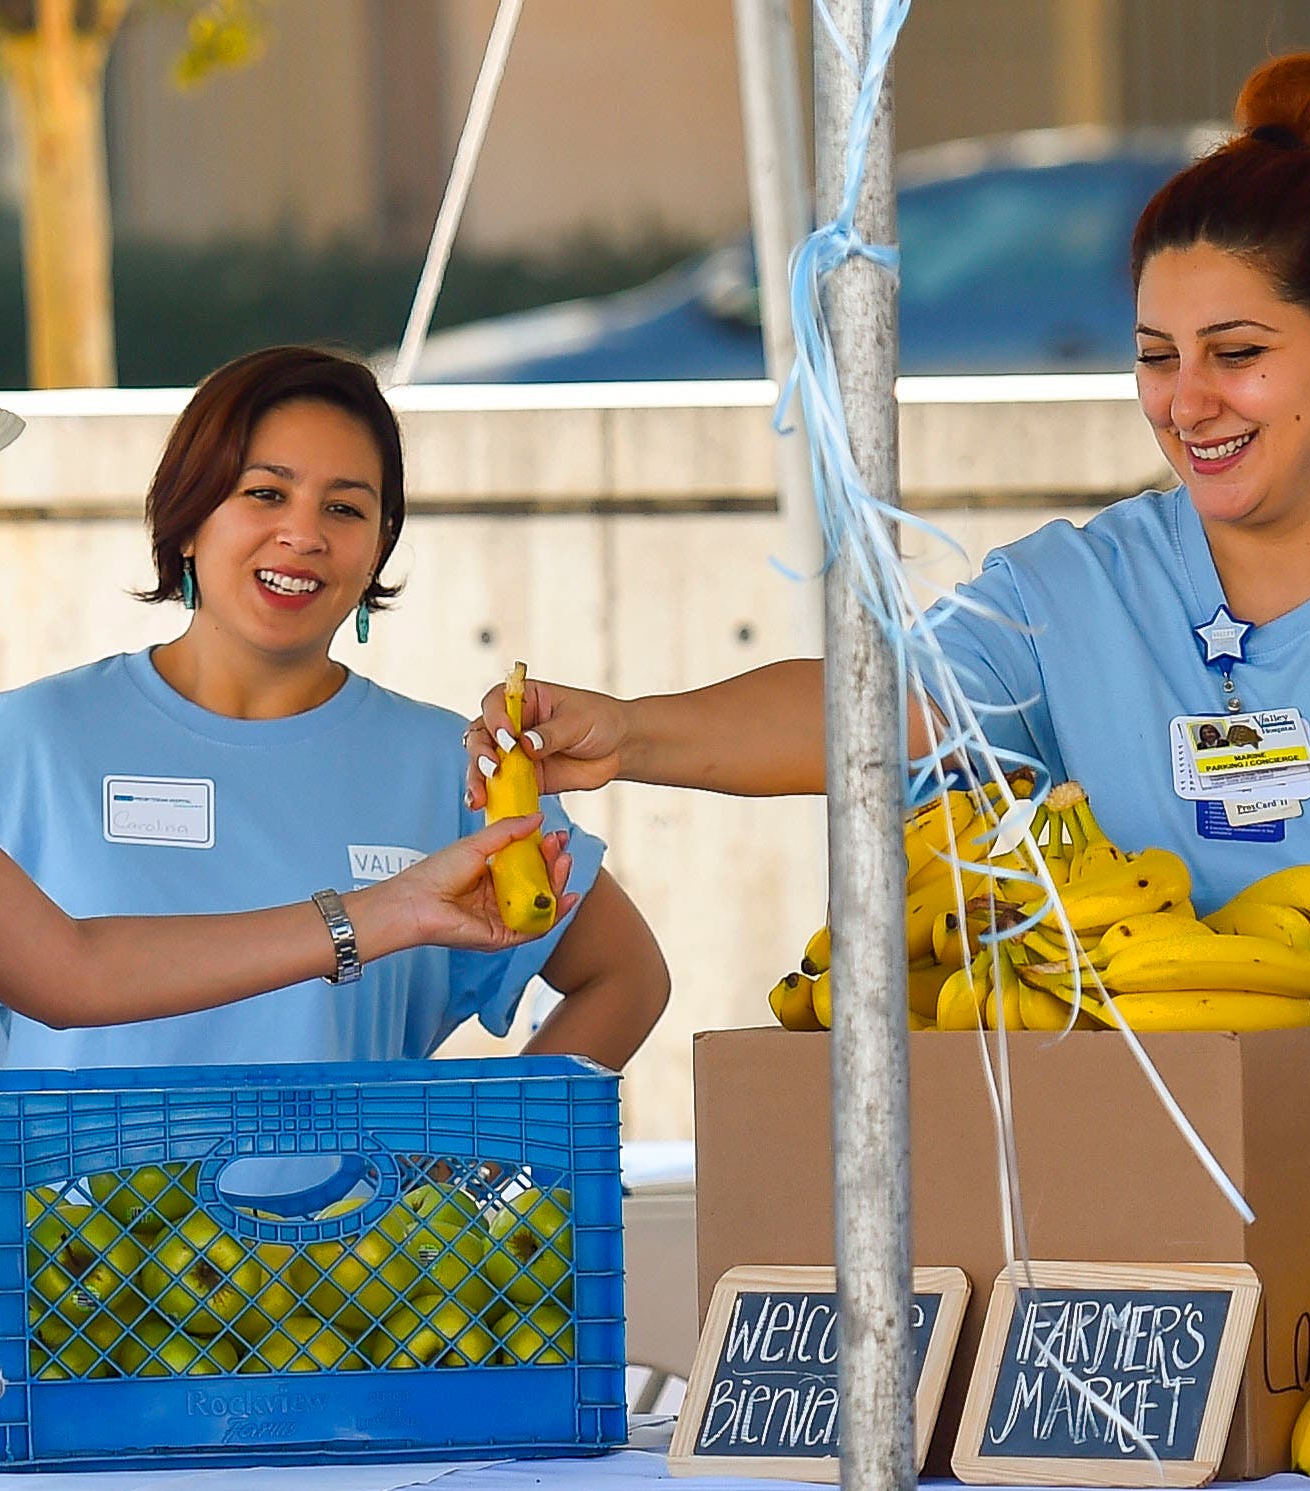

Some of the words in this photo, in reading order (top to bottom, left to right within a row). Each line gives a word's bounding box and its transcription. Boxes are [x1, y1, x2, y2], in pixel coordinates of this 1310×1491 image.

[1206, 762, 1244, 772] PARKING
[1249, 755, 1300, 767] CONCIERGE
[1016, 1300, 1205, 1387] FARMER'S
[990, 1371, 1196, 1453] MARKET
